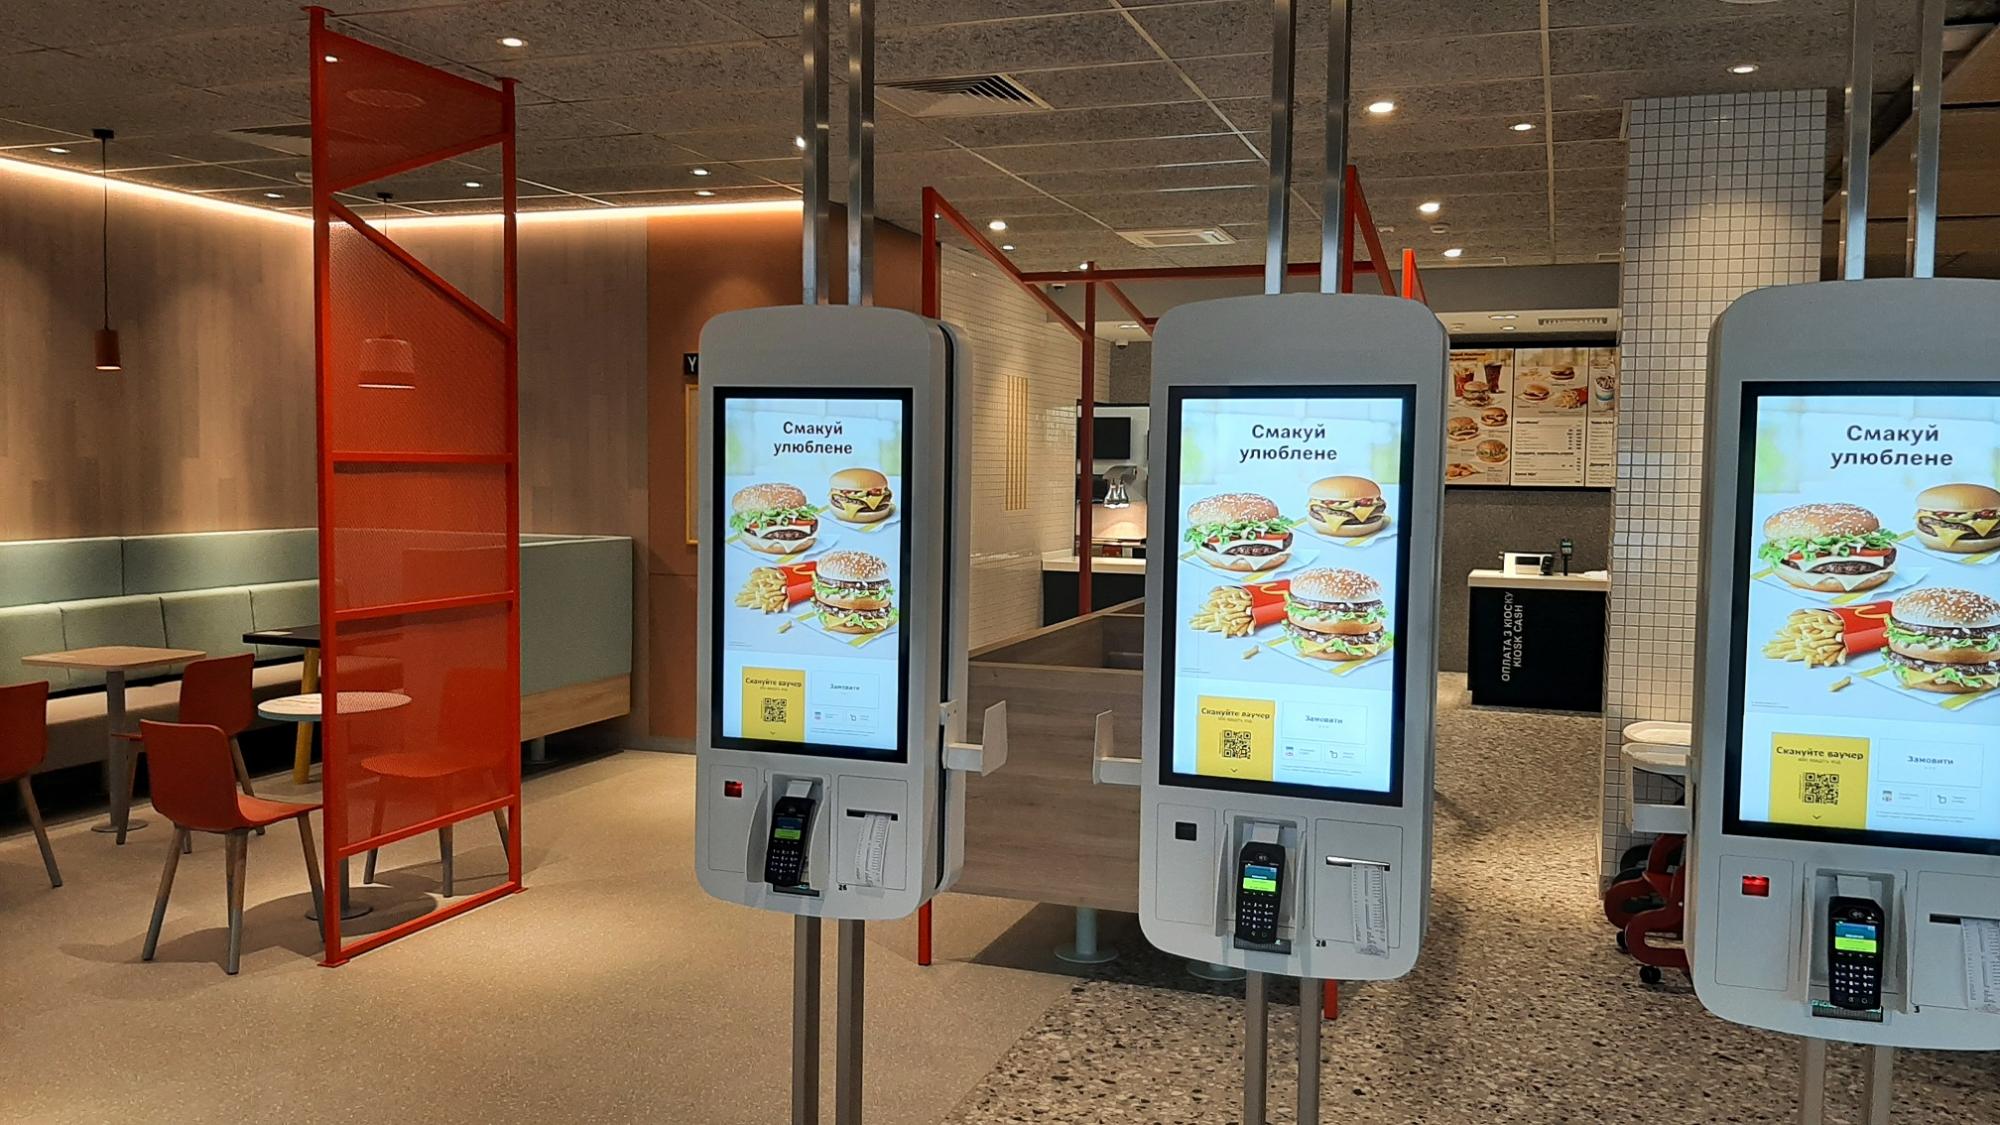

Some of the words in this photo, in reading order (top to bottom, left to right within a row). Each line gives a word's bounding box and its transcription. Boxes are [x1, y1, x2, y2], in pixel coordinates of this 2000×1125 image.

[783, 421, 843, 437] Смакуй
[1251, 424, 1326, 442] Смакуй
[1846, 425, 1939, 446] Смакуй
[773, 441, 853, 456] улюблене
[1239, 446, 1338, 463] улюблене
[1830, 449, 1953, 469] улюблене
[1503, 591, 1514, 628] КІОСКУ
[1513, 604, 1523, 633] CASH
[1501, 638, 1512, 682] ОПЛАТА
[1512, 635, 1523, 668] KIOSK
[1201, 707, 1240, 718] Скануйте
[1776, 746, 1825, 759] Скануйте
[1827, 751, 1864, 762] ваучер
[1907, 755, 1954, 765] Замовити
